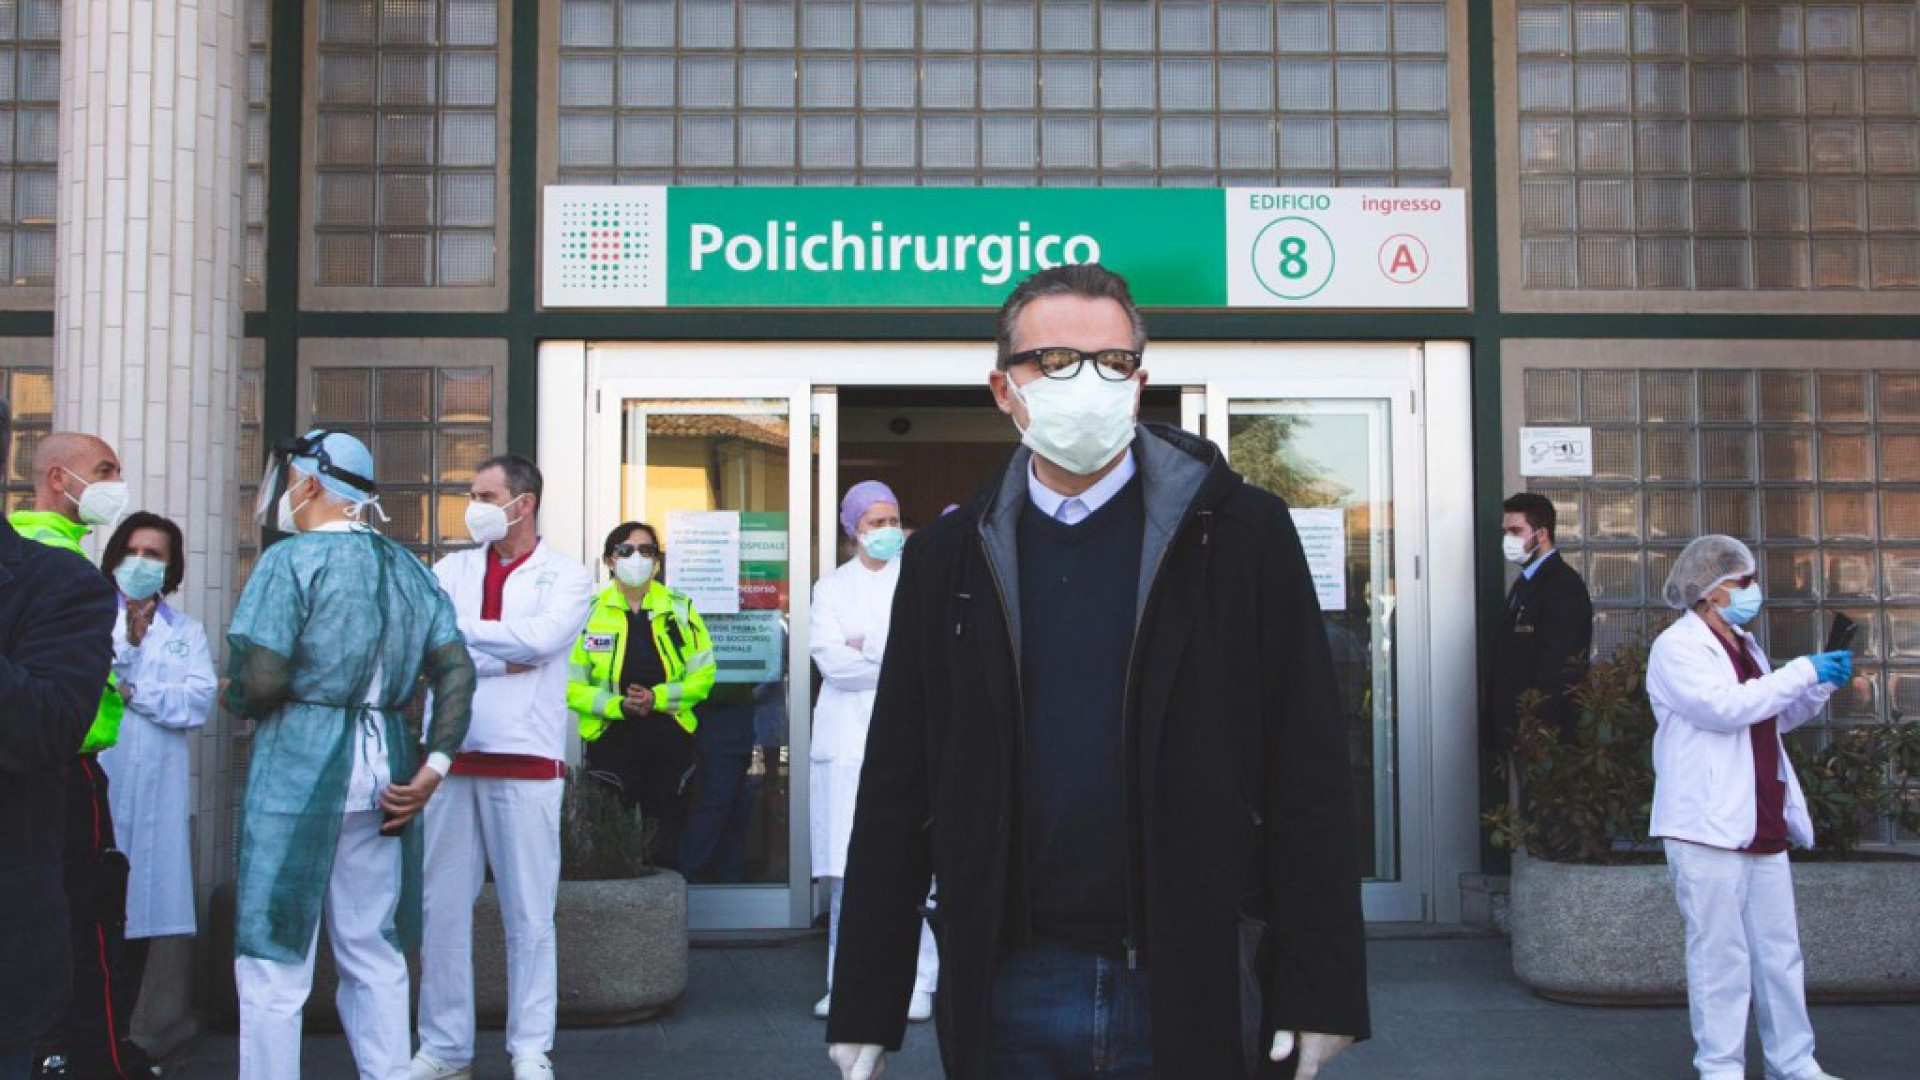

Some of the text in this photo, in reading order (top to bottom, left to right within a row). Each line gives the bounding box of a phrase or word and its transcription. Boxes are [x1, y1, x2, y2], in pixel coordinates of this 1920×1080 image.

[1250, 194, 1330, 211] EDIFICIO
[1362, 194, 1442, 215] ingresso
[689, 219, 1100, 285] Polichirurgico
[1278, 236, 1308, 279] 8
[1389, 243, 1417, 274] A
